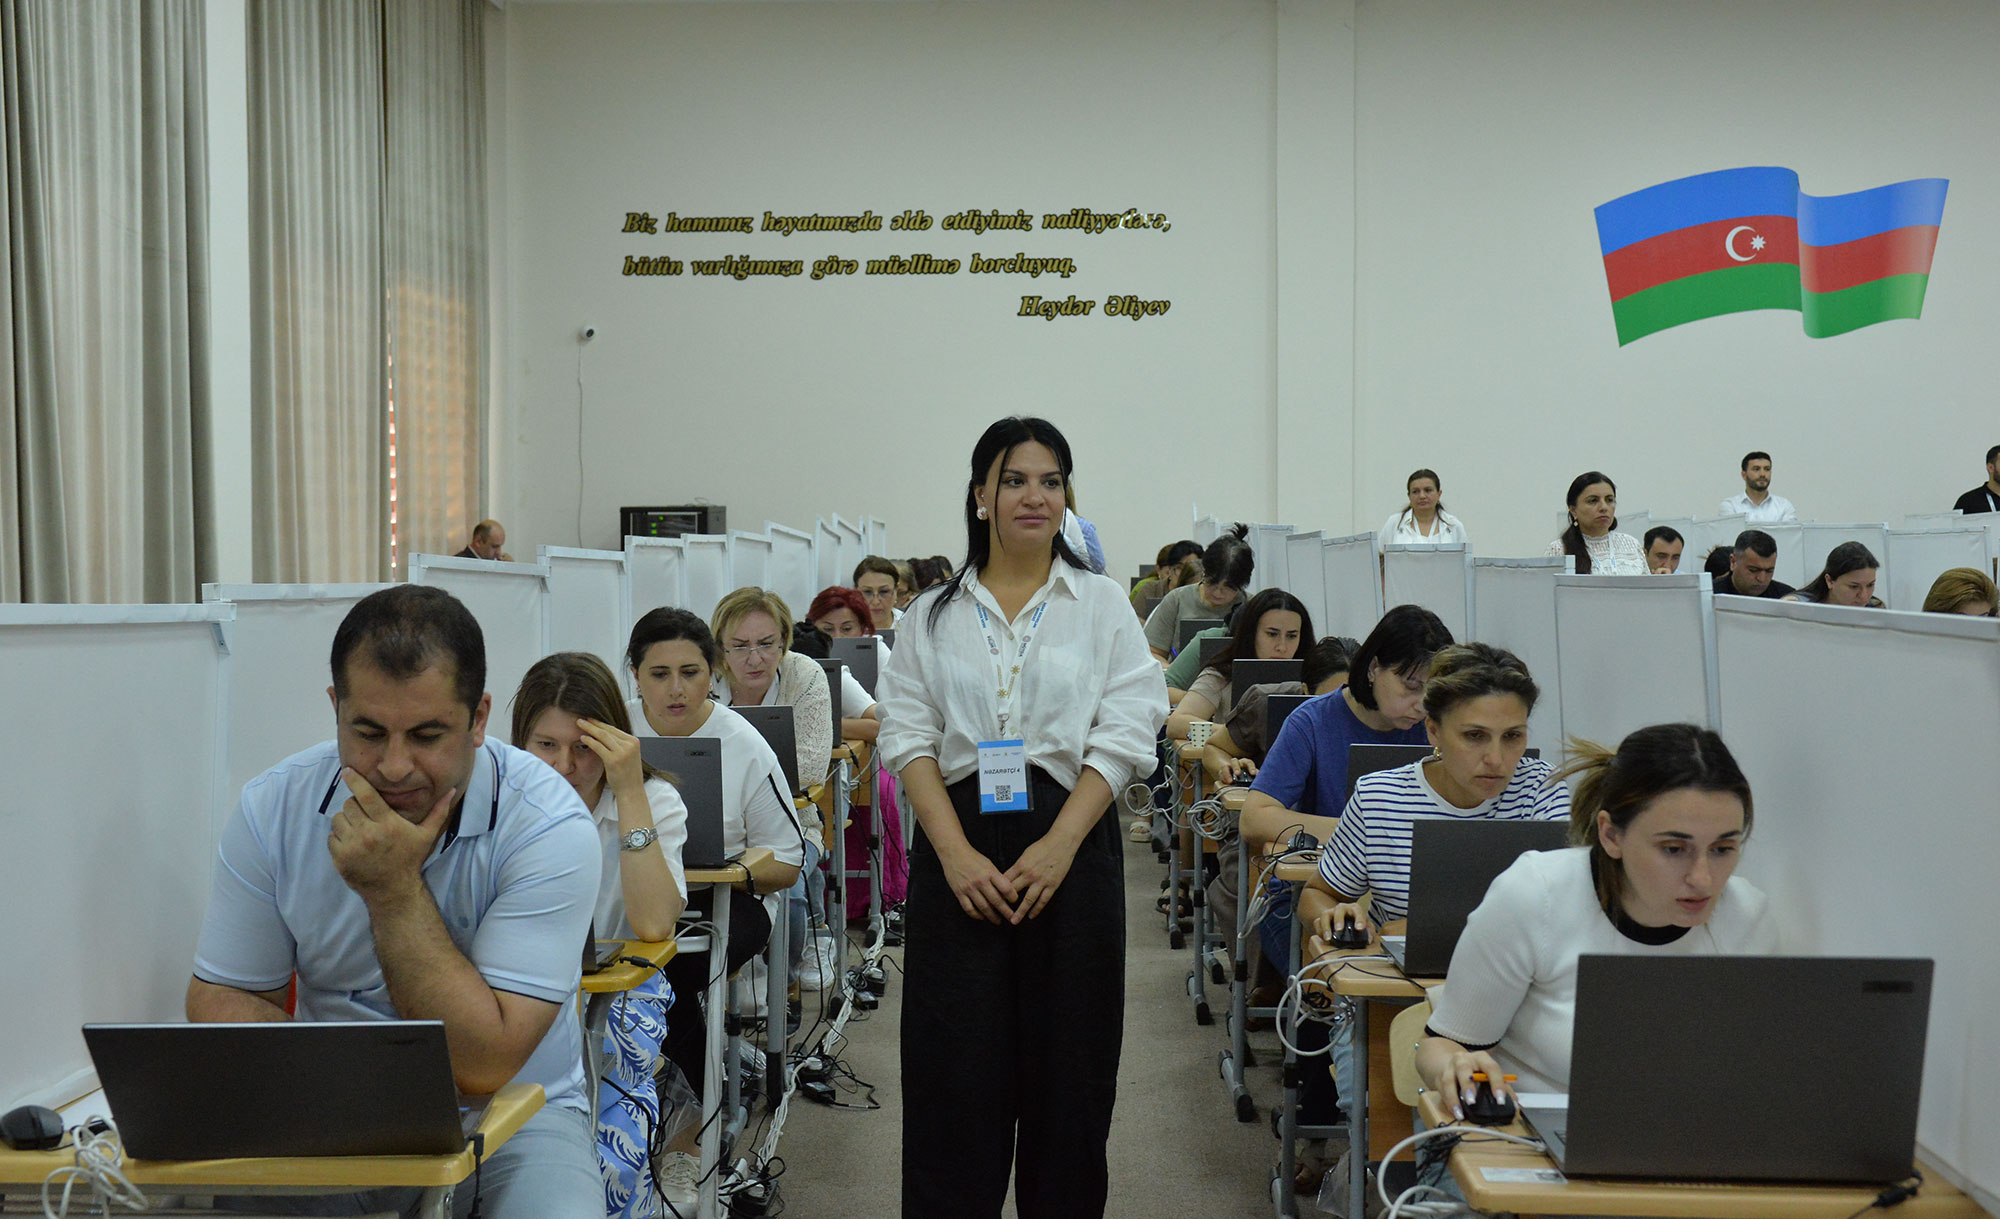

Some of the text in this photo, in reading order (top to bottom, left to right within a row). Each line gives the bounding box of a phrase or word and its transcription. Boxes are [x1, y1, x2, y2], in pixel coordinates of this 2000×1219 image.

[620, 211, 659, 235] Biz
[664, 211, 755, 235] hamımız
[760, 210, 884, 237] həyatımızda
[889, 209, 934, 232] əldə
[940, 208, 1034, 235] etdiyimiz
[621, 252, 1078, 281] bütün varlığımıza görə müəllimə borcluyuq.
[1016, 294, 1172, 322] Heydər Əliyev
